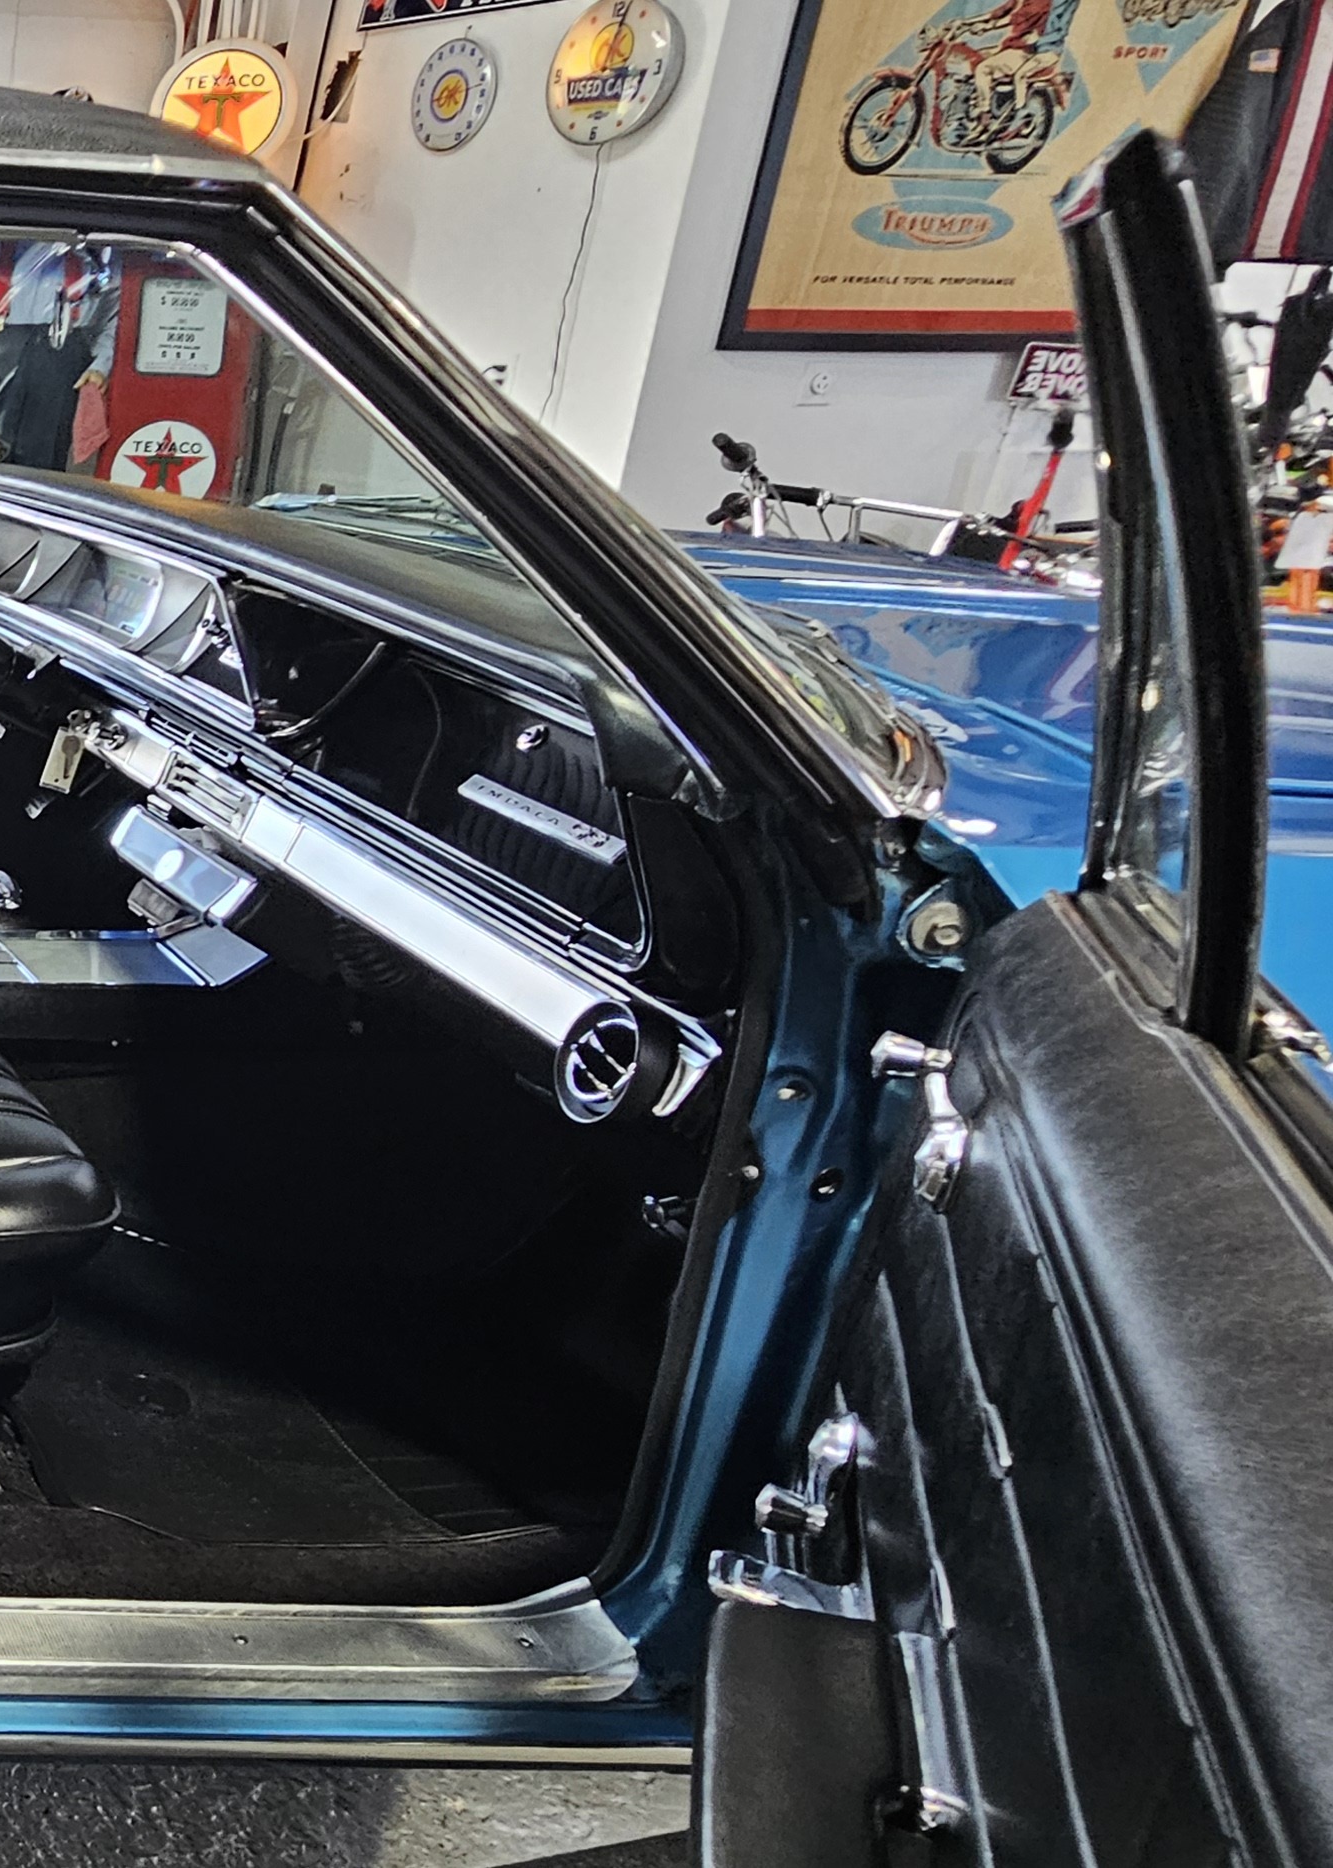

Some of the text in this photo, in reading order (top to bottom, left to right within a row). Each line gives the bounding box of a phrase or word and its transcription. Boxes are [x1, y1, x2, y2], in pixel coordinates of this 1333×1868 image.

[613, 1, 627, 18] 12
[1112, 46, 1168, 60] SPORT
[653, 58, 663, 76] 3
[185, 73, 266, 90] TEXACO
[569, 80, 603, 100] USED
[883, 208, 991, 233] TRIUMPH
[813, 275, 837, 285] FOR
[133, 440, 203, 455] TEXACO
[477, 784, 561, 827] IMPALA
